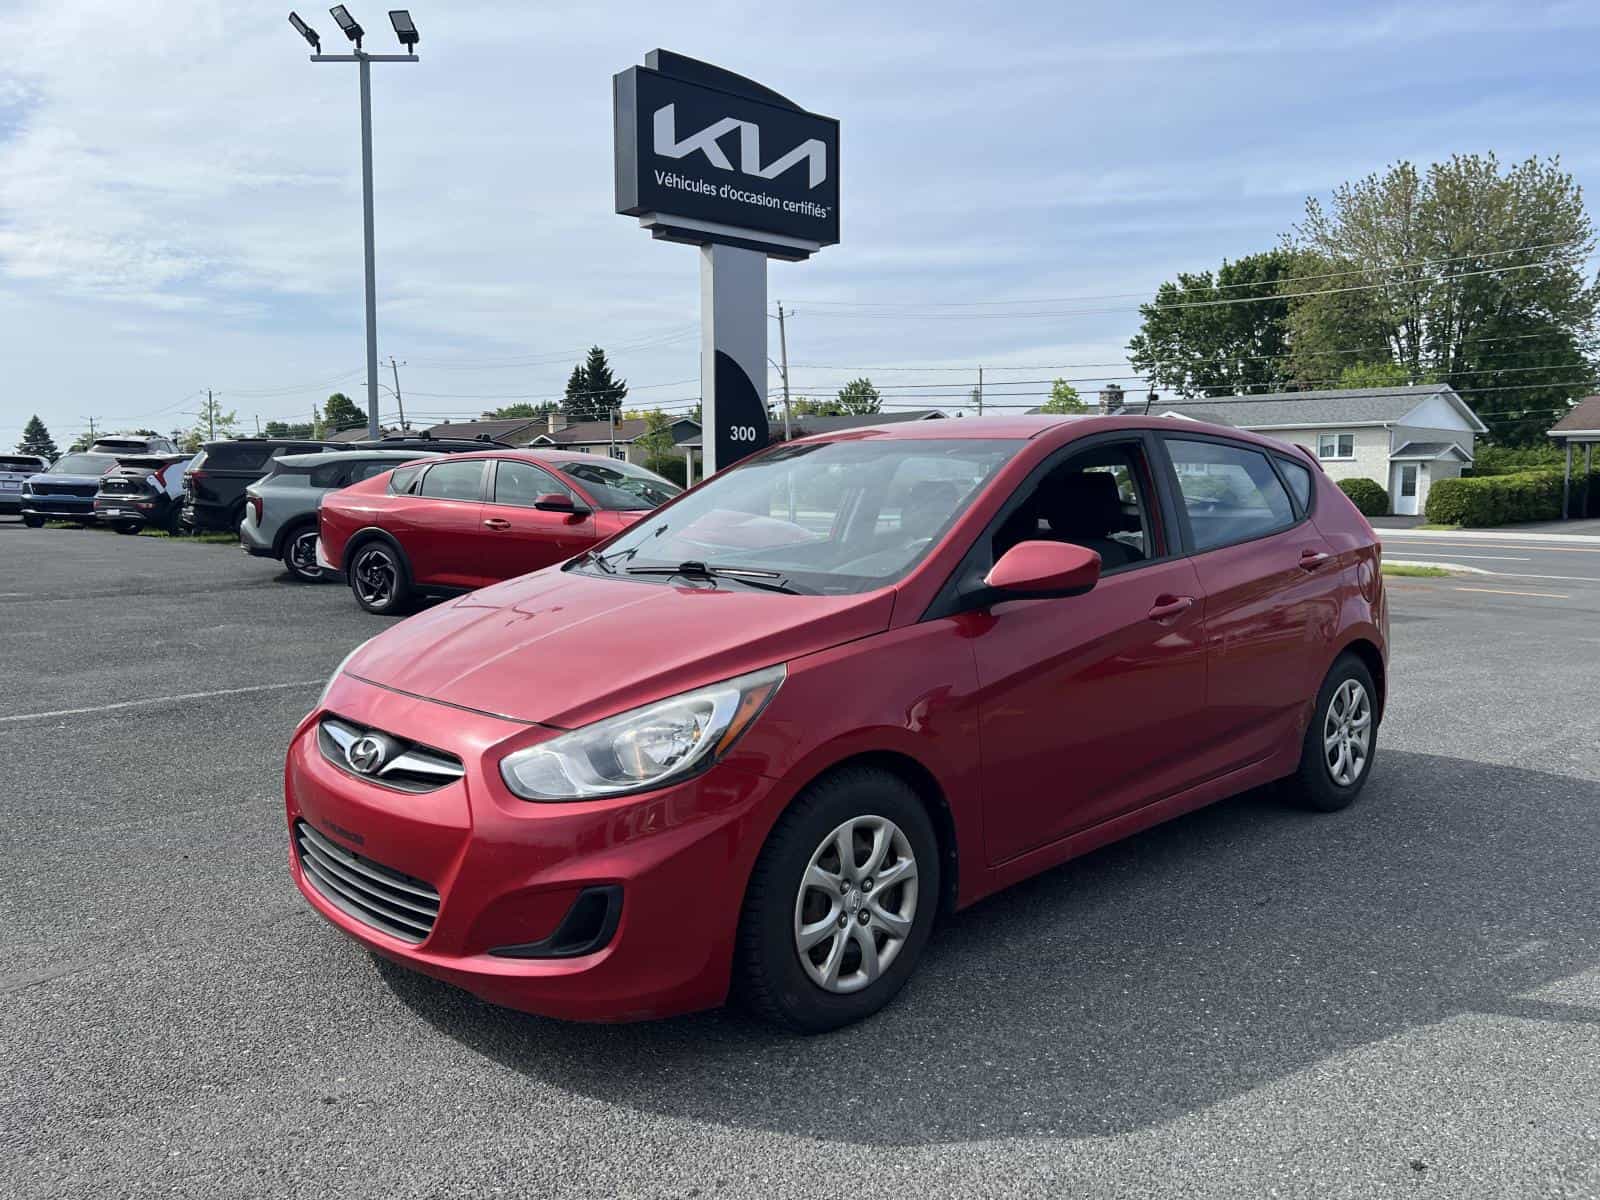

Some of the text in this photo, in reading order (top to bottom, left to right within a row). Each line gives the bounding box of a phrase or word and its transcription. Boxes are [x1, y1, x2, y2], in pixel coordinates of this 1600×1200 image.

[653, 102, 827, 190] KIA
[654, 169, 827, 219] Véhicules d'occasion certifiés
[730, 425, 756, 441] 300
